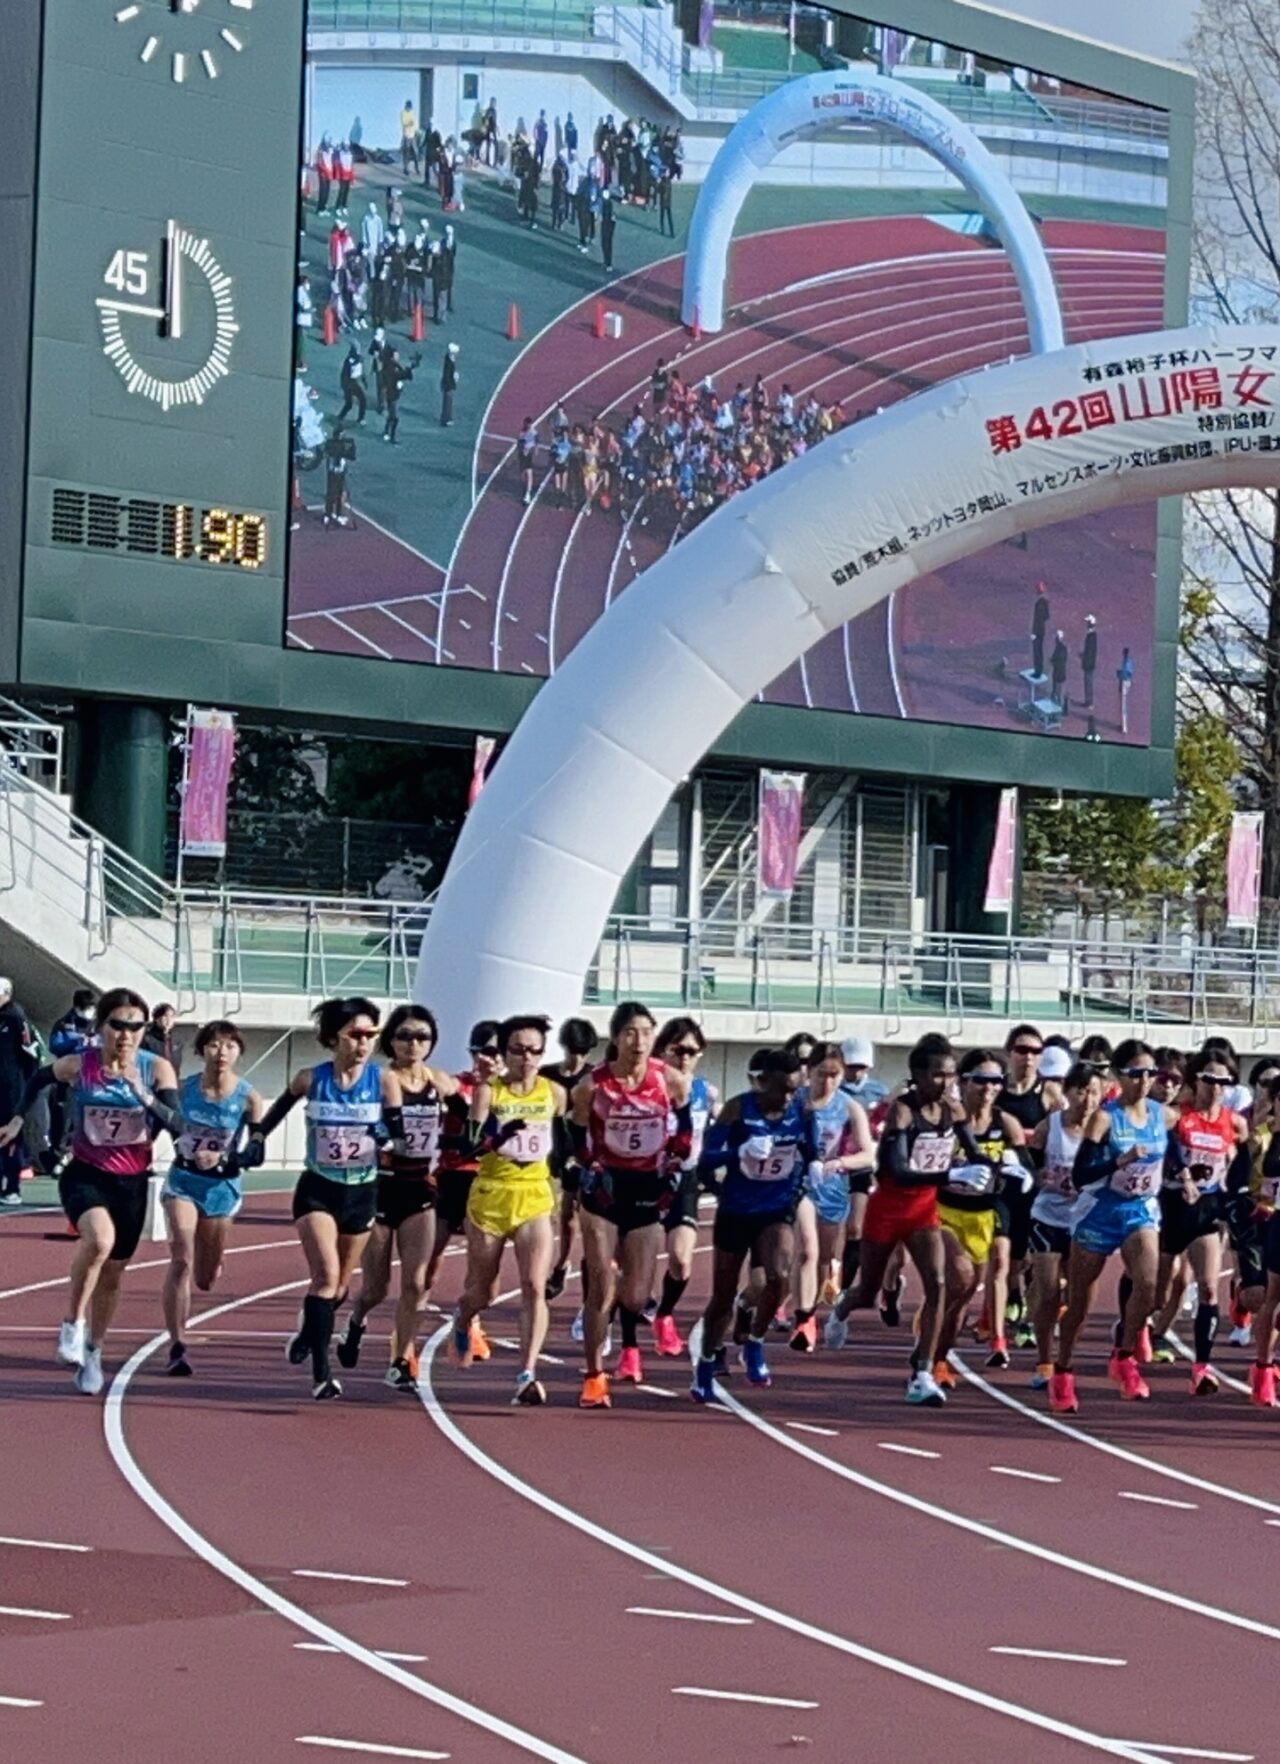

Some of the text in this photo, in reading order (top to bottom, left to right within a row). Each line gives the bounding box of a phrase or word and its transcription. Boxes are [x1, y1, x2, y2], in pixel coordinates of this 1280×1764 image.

[104, 249, 148, 295] 45
[109, 1121, 121, 1138] 7
[405, 1132, 431, 1150] 27
[516, 1135, 540, 1153] 16
[629, 1133, 641, 1150] 5
[329, 1142, 360, 1160] 32
[758, 1159, 782, 1174] 15
